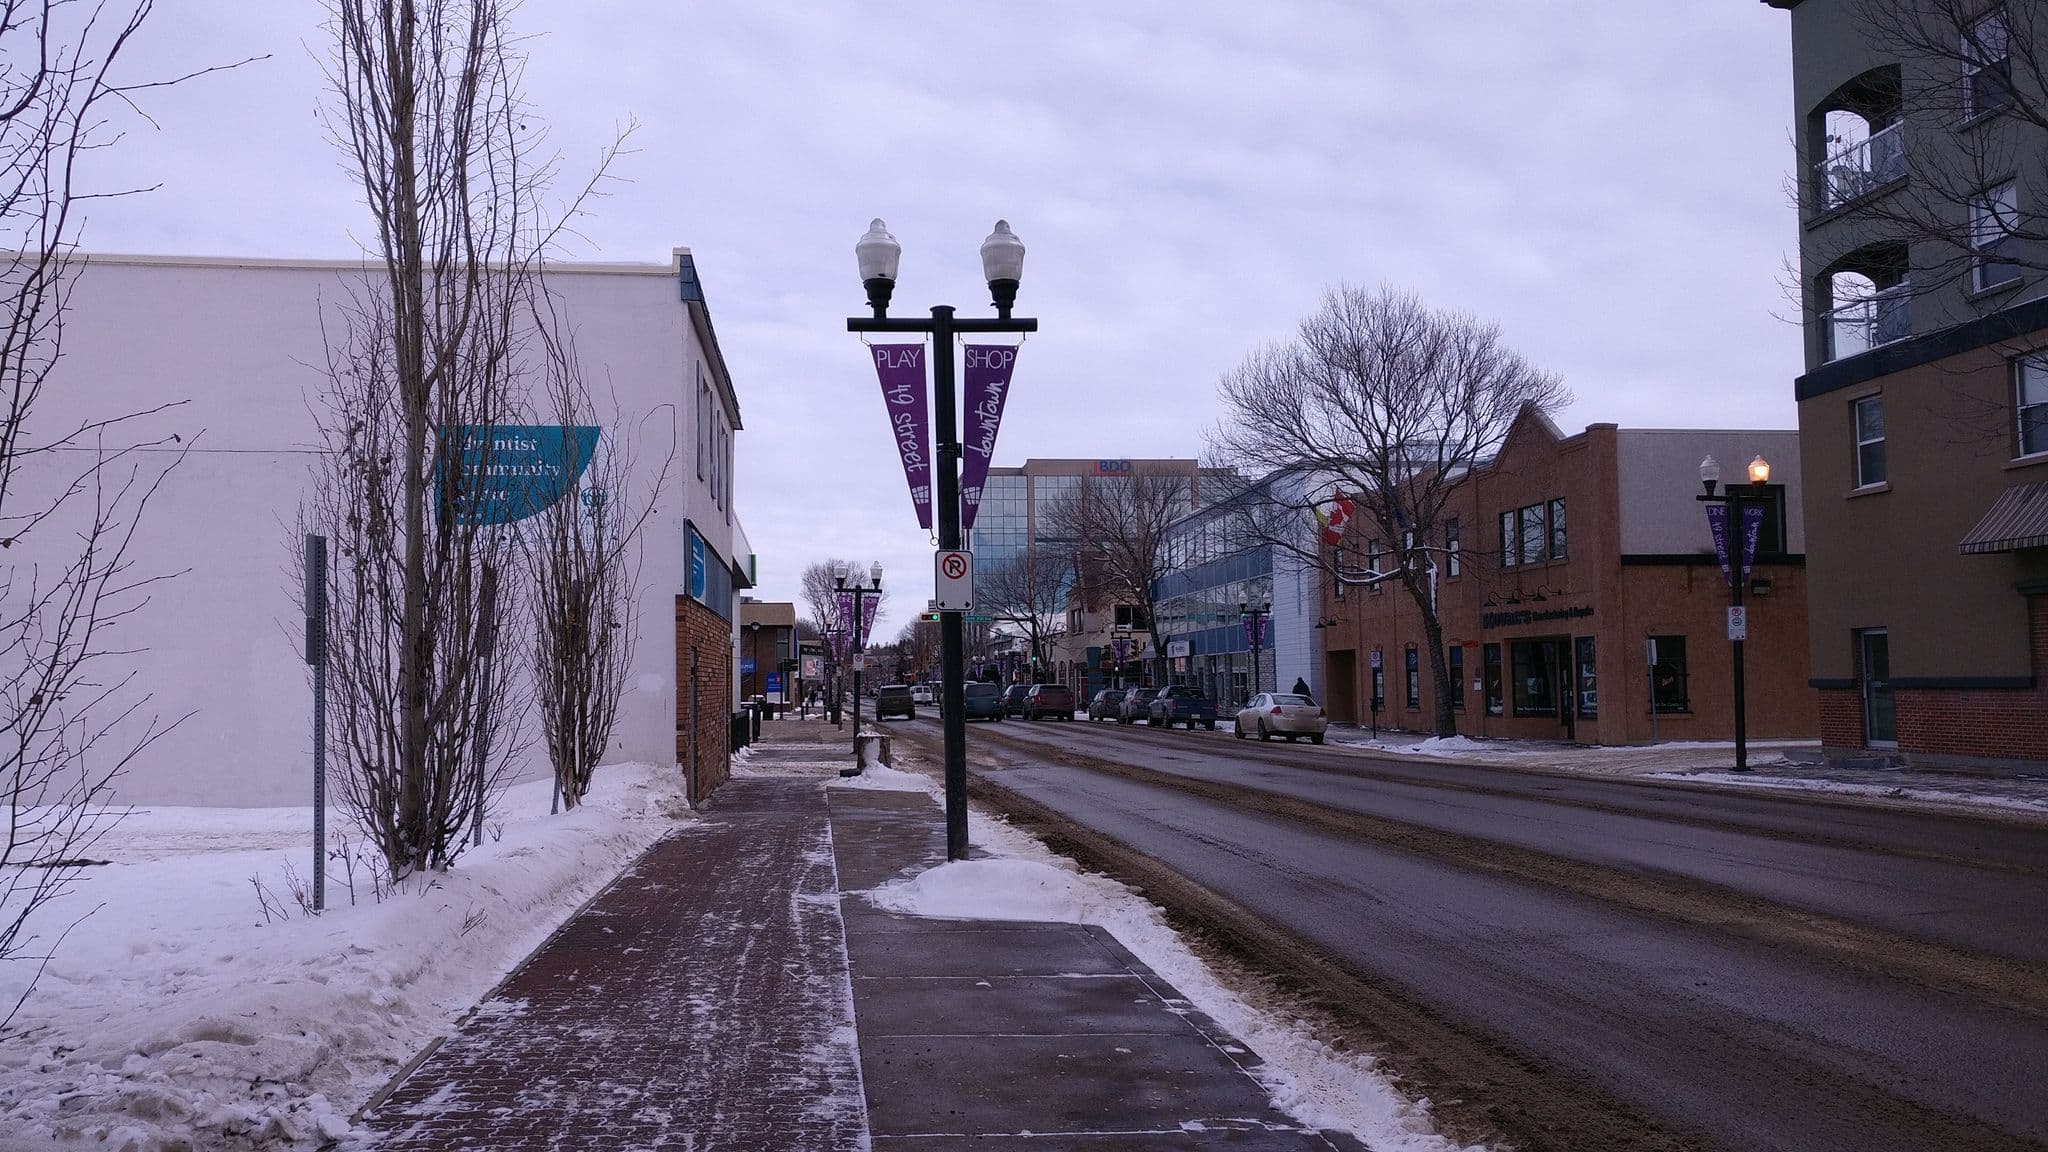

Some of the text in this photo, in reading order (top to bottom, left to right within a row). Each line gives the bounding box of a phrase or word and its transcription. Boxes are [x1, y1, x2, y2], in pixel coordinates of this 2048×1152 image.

[877, 349, 920, 369] PLAY
[966, 348, 1014, 369] SHOP
[887, 384, 929, 473] 49 street
[966, 379, 1005, 458] downtown
[1100, 460, 1131, 473] BDO
[1708, 505, 1726, 516] DINE
